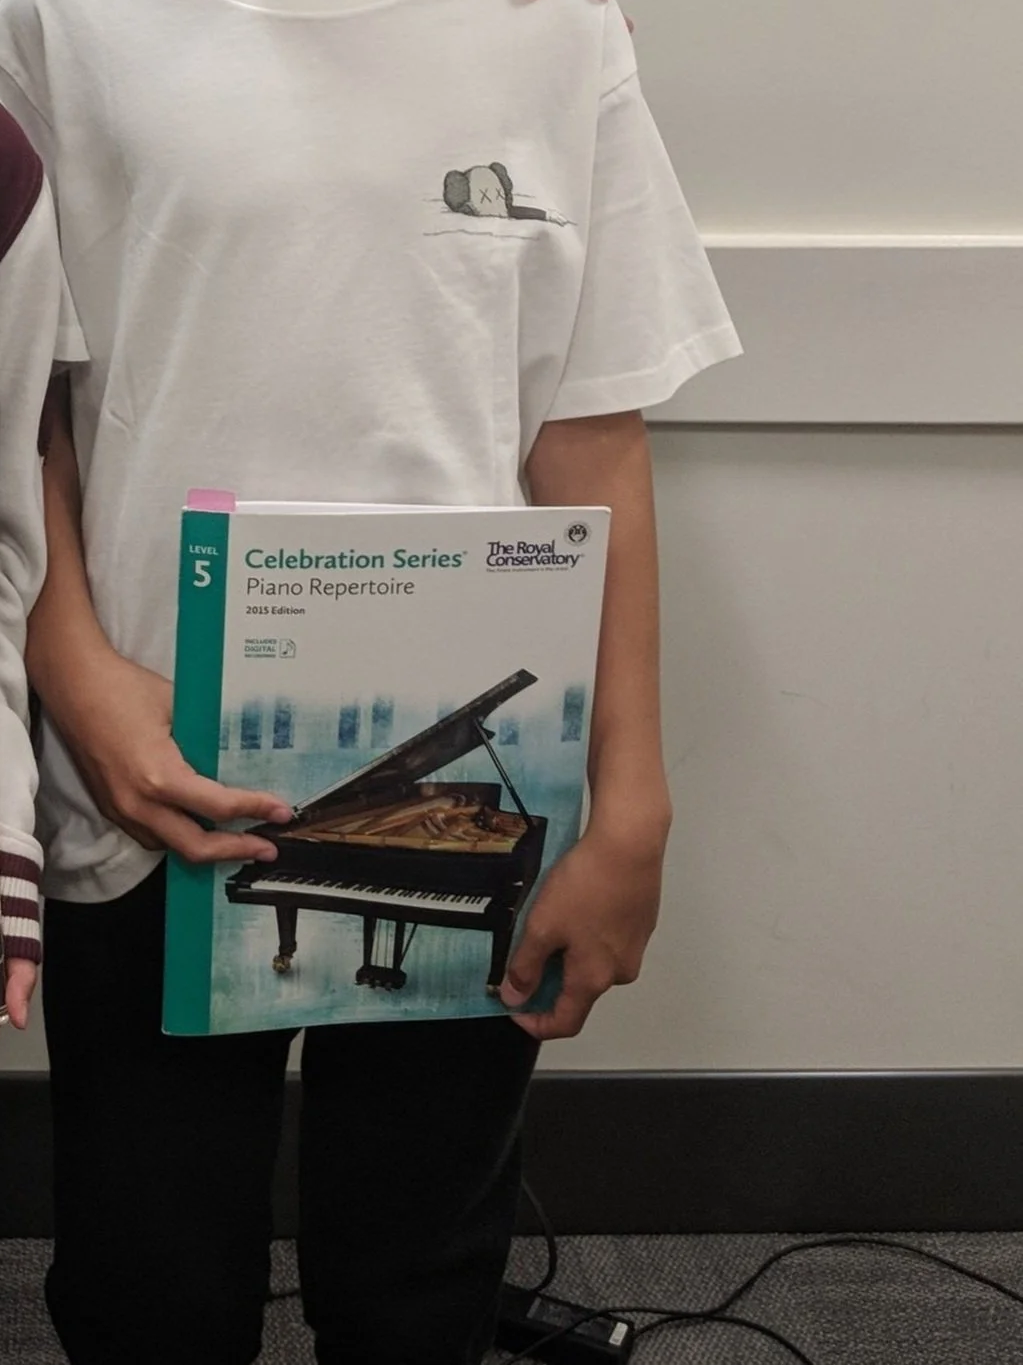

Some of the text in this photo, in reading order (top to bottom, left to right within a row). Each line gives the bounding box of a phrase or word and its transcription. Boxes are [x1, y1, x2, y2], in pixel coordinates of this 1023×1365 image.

[189, 544, 218, 555] LEVEL
[487, 539, 556, 555] The Royal
[245, 548, 384, 569] Celebration
[486, 554, 580, 568] Conservatory
[193, 560, 212, 588] 5
[246, 577, 416, 600] Piano Repertoire
[245, 606, 305, 615] 2015 Edition
